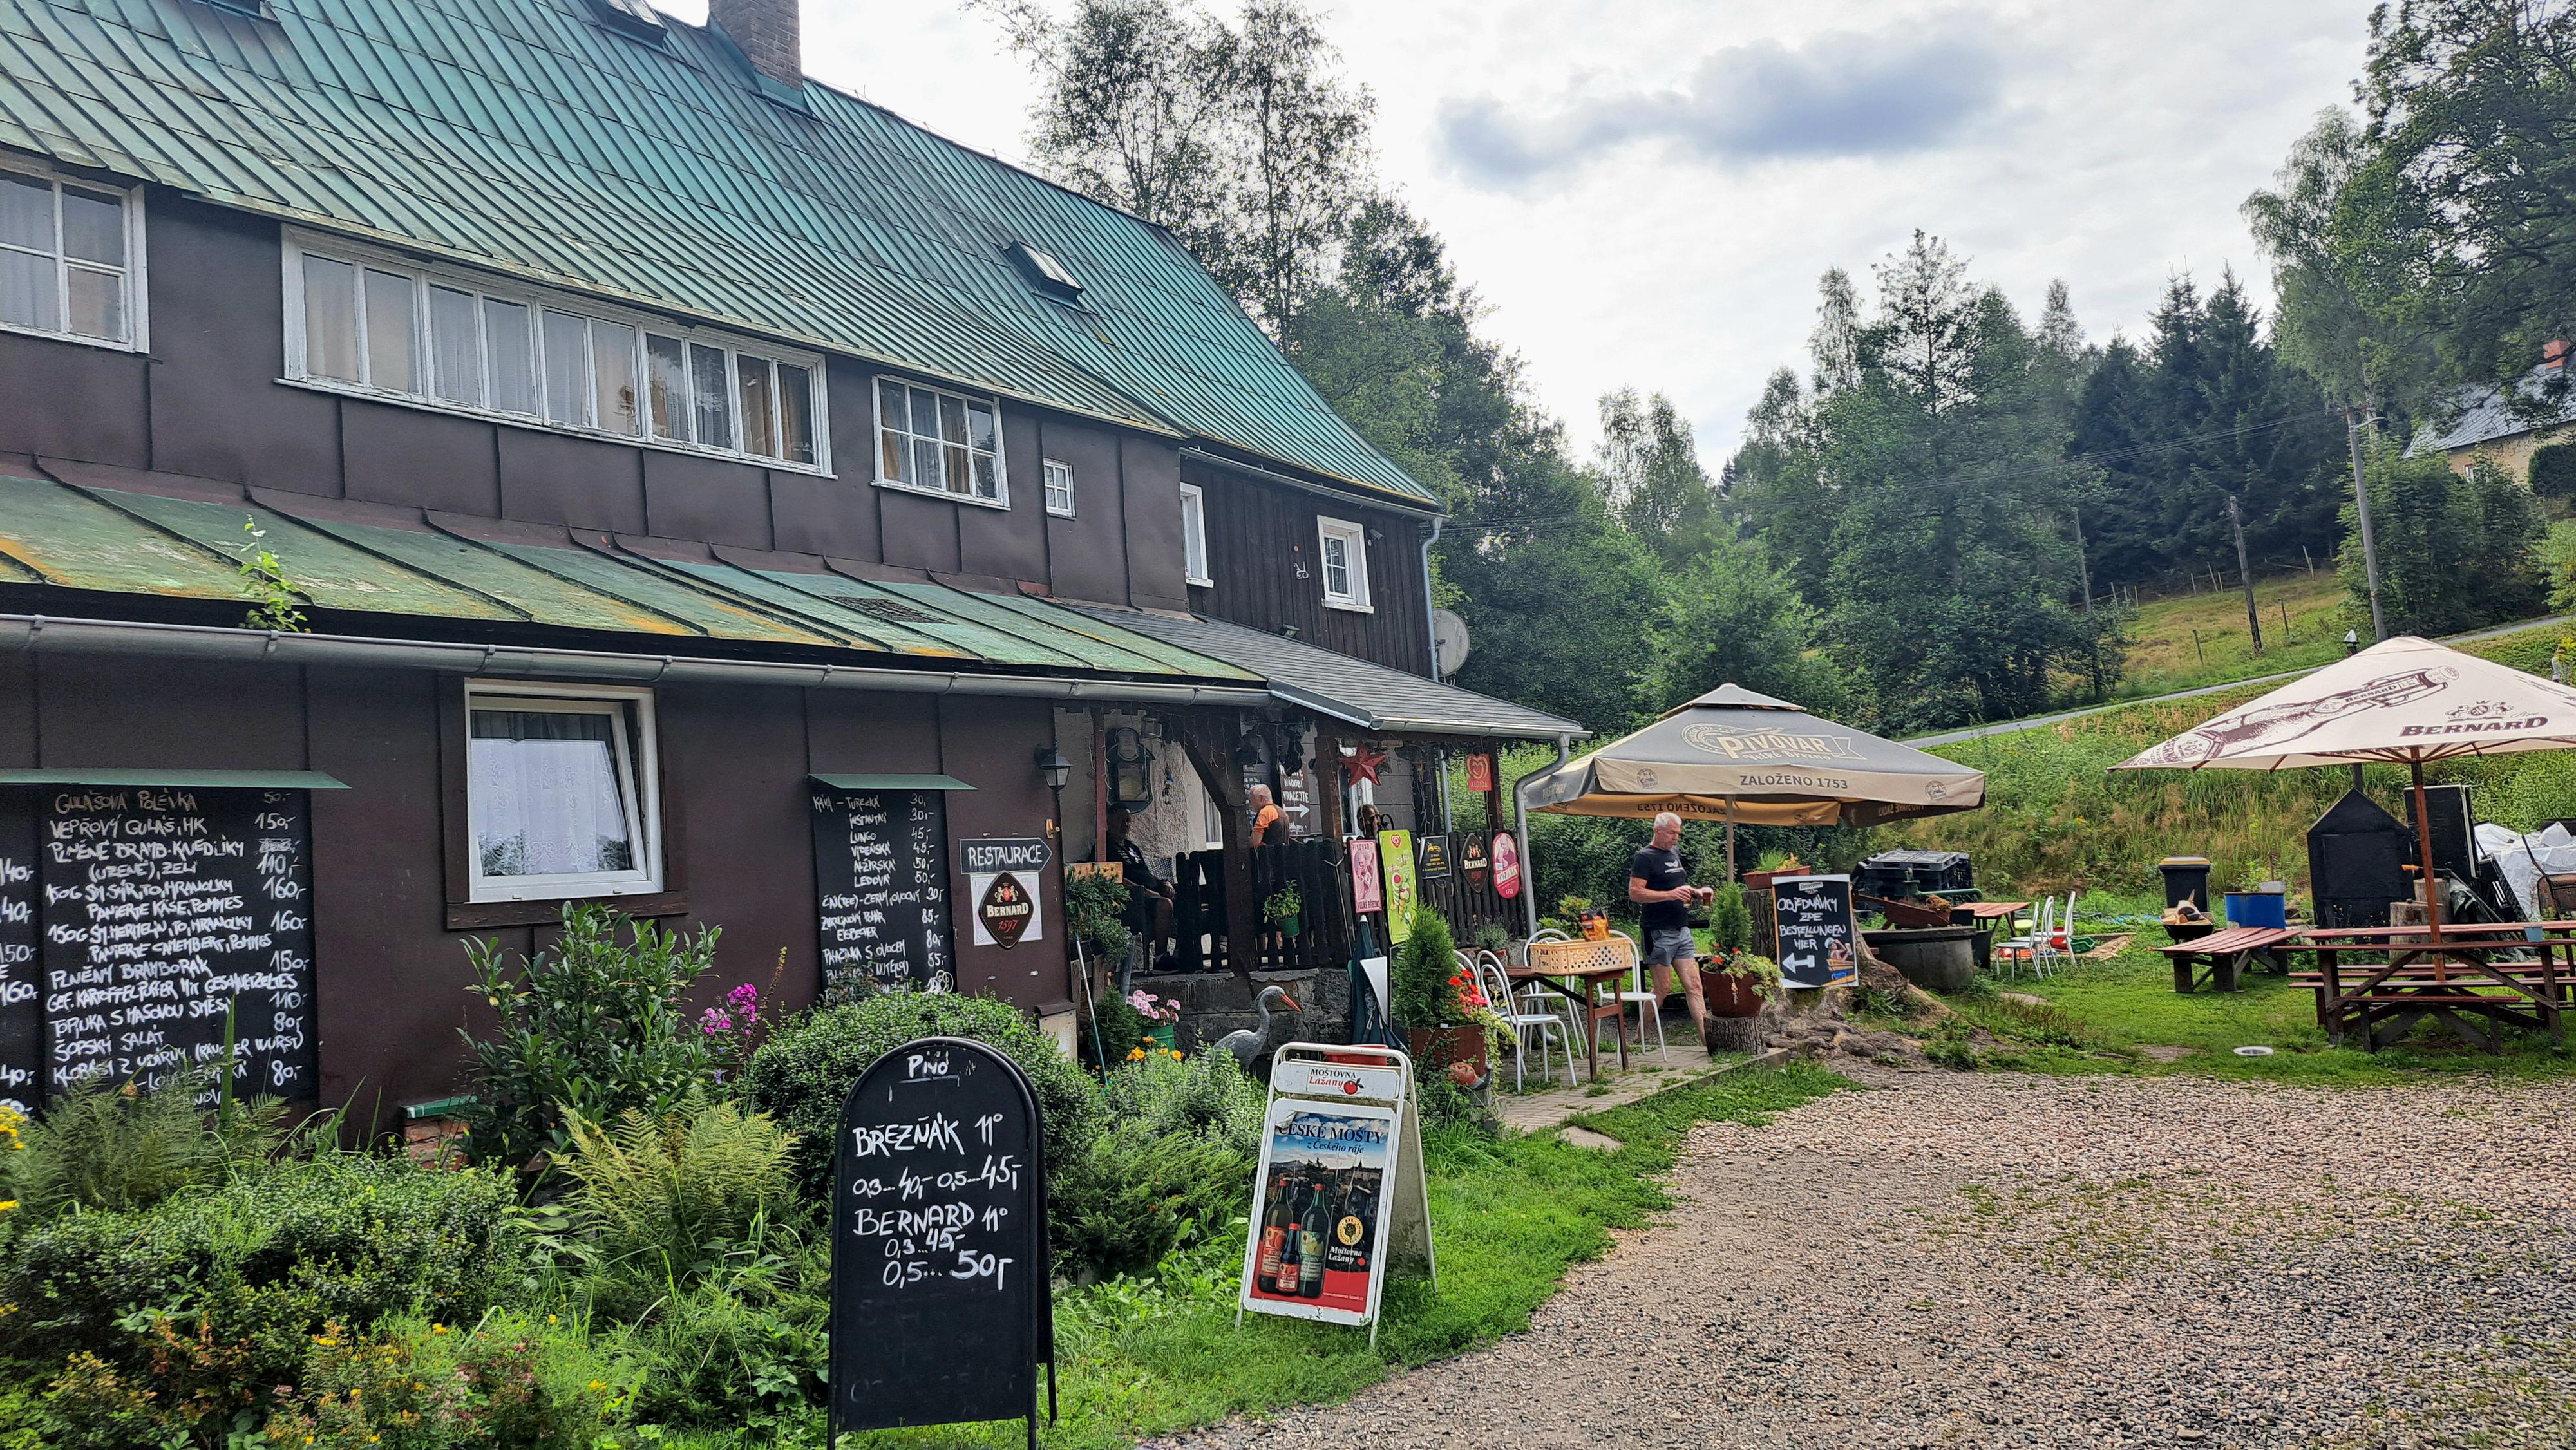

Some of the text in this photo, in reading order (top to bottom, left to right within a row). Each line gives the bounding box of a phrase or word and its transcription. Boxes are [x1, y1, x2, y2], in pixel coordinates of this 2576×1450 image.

[2345, 685, 2396, 702] BERNARD
[2399, 717, 2548, 737] BERNARD
[1717, 737, 1832, 758] PIVOVAR
[1740, 773, 1848, 789] ZALOŽENO 1753
[1283, 791, 1309, 803] VRACEJTE
[850, 831, 876, 843] LUNGO
[968, 844, 1043, 867] RESTAURACE
[1464, 858, 1488, 869] BERNARD
[987, 902, 1029, 918] BERNARD
[1799, 912, 1823, 922] ZDE
[998, 919, 1019, 932] 1597
[1779, 924, 1846, 937] BESTELLUNGEN
[865, 945, 873, 959] S
[1794, 939, 1817, 950] HIER
[110, 1010, 124, 1025] S
[1309, 1076, 1344, 1089] Lažany
[852, 1111, 965, 1158] BŘEZŇÁK
[1330, 1125, 1384, 1144] MOŠTY
[1313, 1139, 1346, 1152] Českého
[1348, 1143, 1364, 1155] ráje
[853, 1201, 976, 1236] BERNARD
[1328, 1254, 1355, 1265] Lažany
